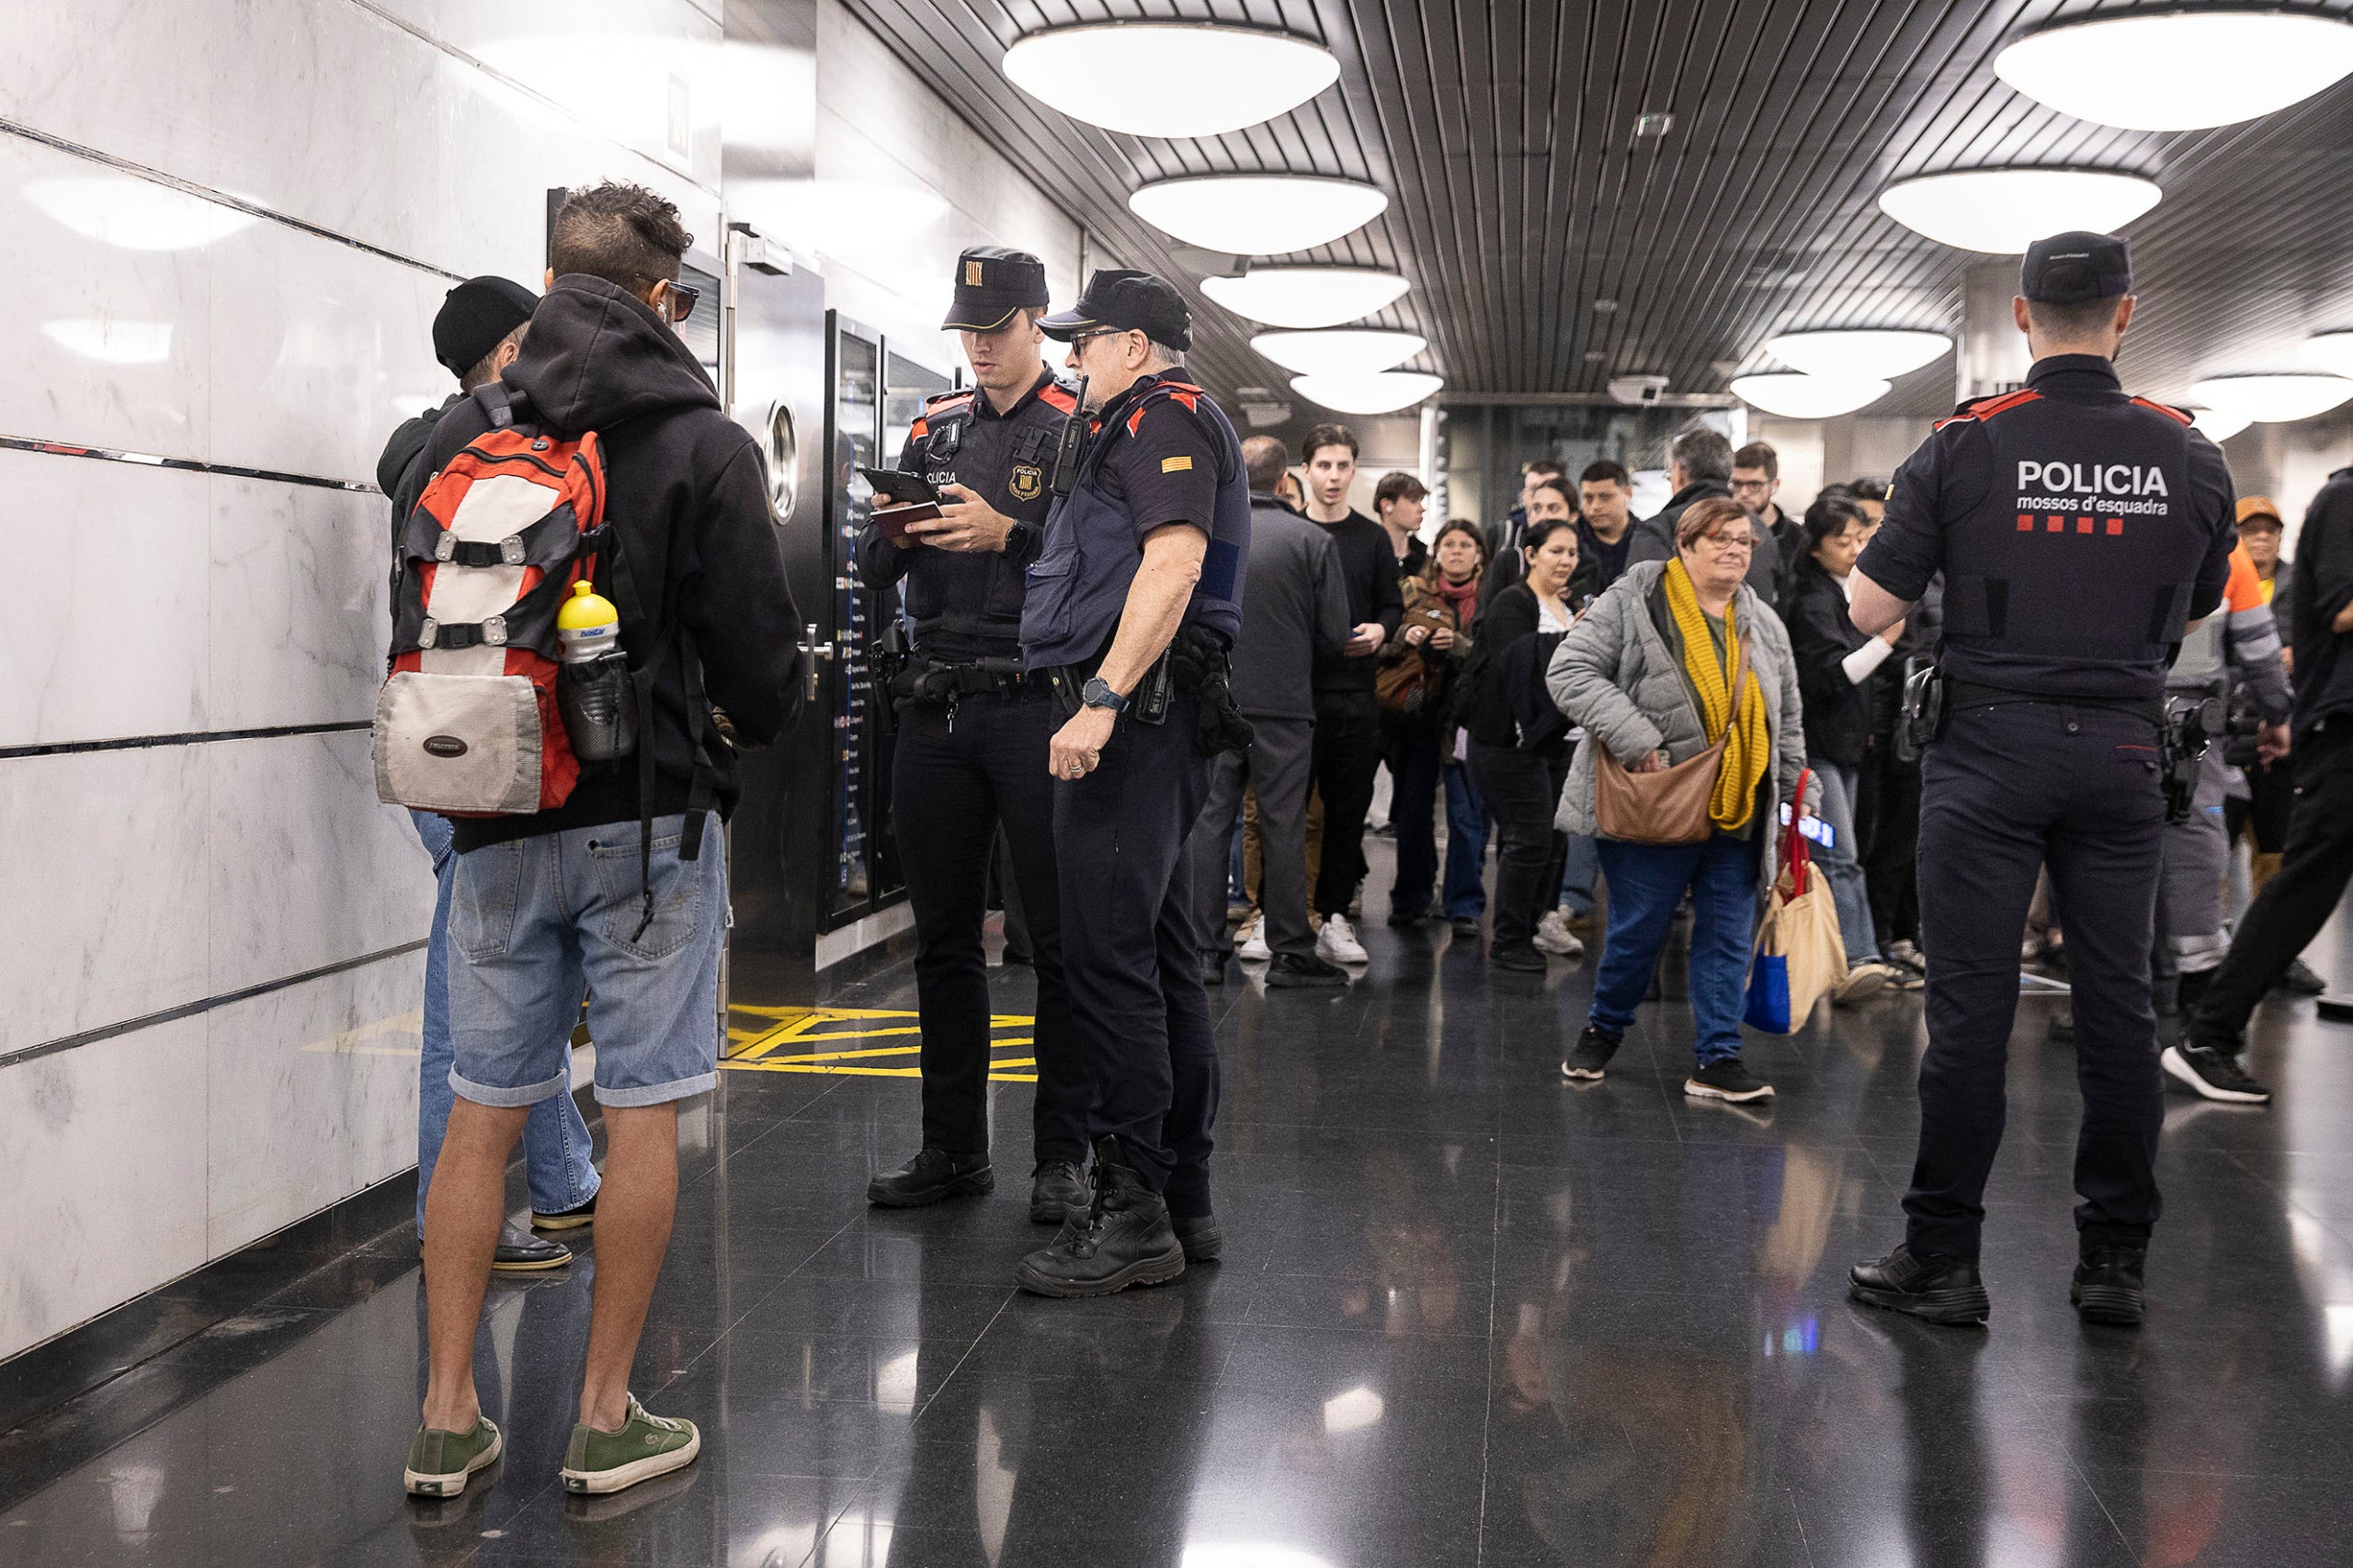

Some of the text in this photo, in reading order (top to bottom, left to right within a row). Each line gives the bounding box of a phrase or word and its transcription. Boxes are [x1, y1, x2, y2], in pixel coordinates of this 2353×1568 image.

[926, 472, 956, 484] OLICIA
[2018, 460, 2169, 496] POLICIA
[2017, 495, 2168, 516] mossos d'esquadra
